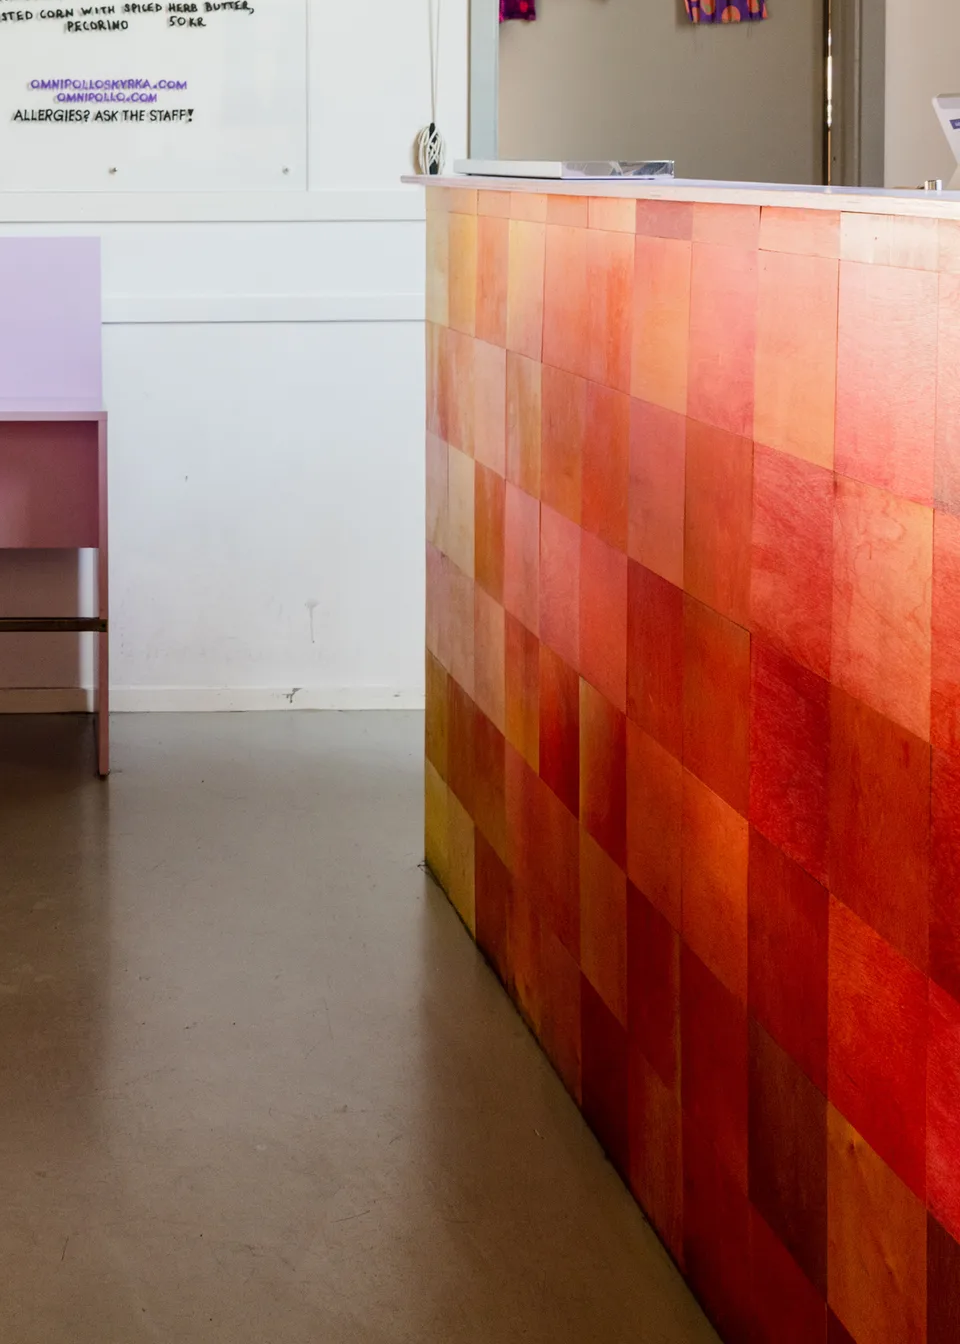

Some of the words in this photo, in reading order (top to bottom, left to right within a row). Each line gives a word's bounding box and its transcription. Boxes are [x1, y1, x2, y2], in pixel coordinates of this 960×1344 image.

[39, 8, 74, 20] CORN
[81, 4, 116, 16] WITH
[123, 2, 163, 14] SPICED
[168, 2, 199, 14] HERB
[66, 19, 129, 34] PECORINO
[169, 16, 186, 27] 50
[189, 16, 207, 28] KR
[30, 79, 188, 91] OMNIPOLLOSKYRKA.COM
[56, 92, 158, 103] OMNIPOLLO.COM
[95, 109, 119, 121] ASK
[122, 109, 146, 122] THE
